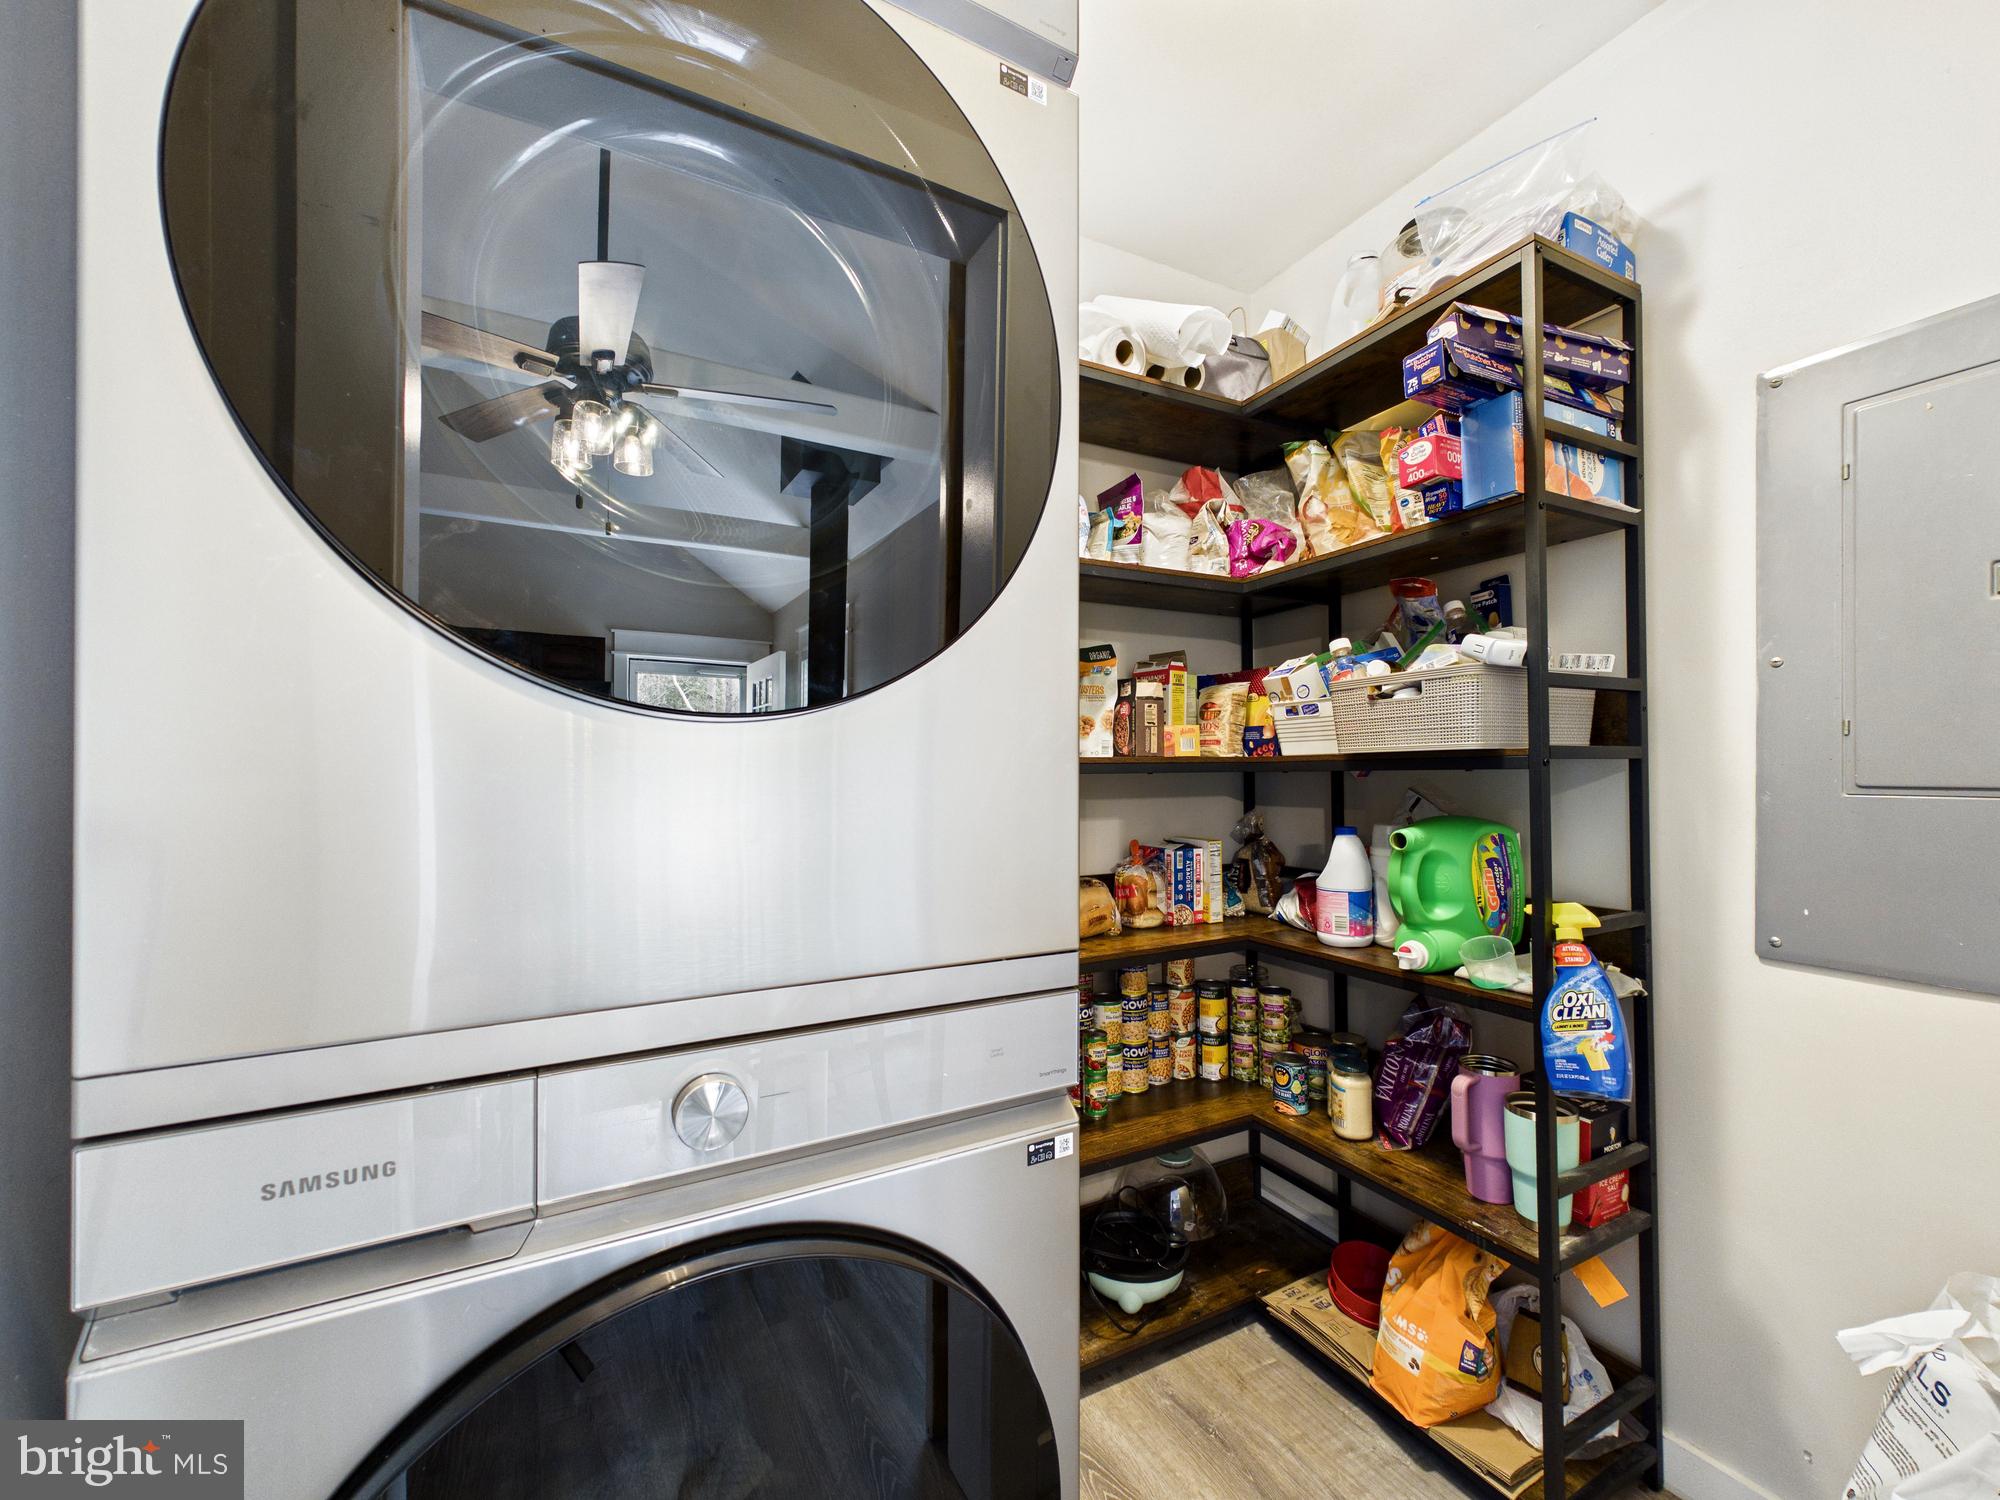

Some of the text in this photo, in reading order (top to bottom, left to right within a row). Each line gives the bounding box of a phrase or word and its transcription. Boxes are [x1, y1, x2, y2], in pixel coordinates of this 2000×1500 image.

[1597, 247, 1613, 268] Cutlery
[1408, 377, 1419, 389] 75
[1407, 469, 1425, 482] 400
[1482, 598, 1498, 607] Patch
[1089, 651, 1111, 660] ORGANIC
[1080, 685, 1105, 695] USTERS
[1484, 868, 1500, 912] Gain
[1122, 999, 1148, 1011] GOYA
[1563, 991, 1594, 1007] OXI
[1080, 1007, 1094, 1021] OY
[1552, 1004, 1606, 1021] CLEAN
[1123, 1046, 1149, 1058] GOYA
[1303, 1048, 1328, 1057] GLOR
[1039, 1067, 1067, 1077] SmartThings
[1603, 1141, 1622, 1153] MORTON
[261, 1160, 397, 1201] SAMSUNG
[1599, 1172, 1625, 1187] ICE CREAM
[1607, 1183, 1619, 1193] SALT
